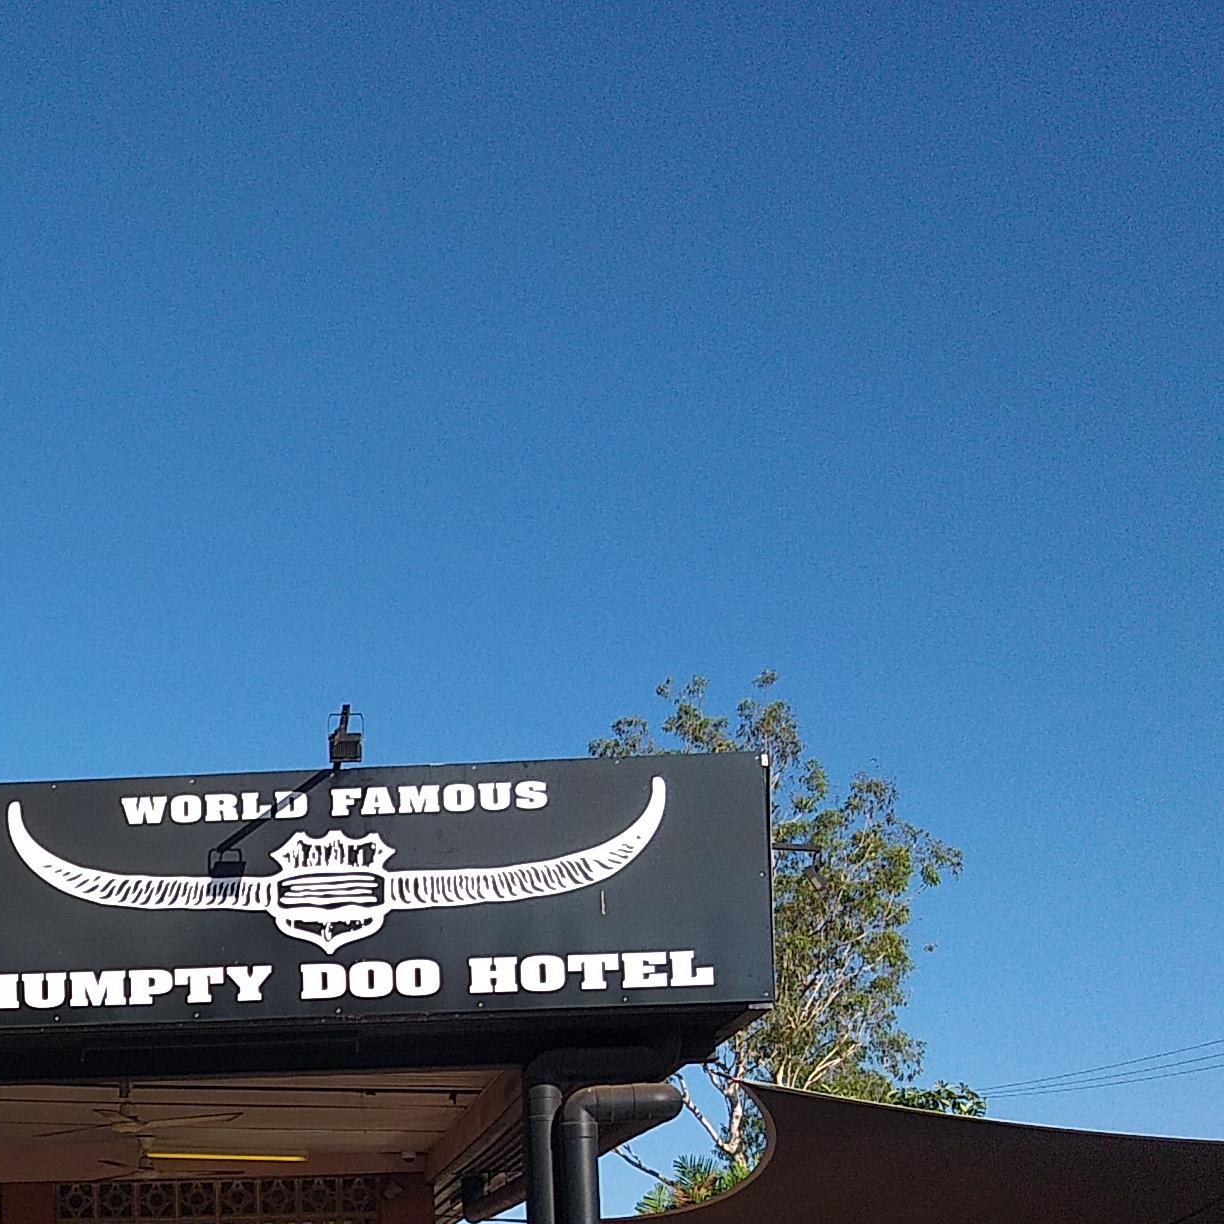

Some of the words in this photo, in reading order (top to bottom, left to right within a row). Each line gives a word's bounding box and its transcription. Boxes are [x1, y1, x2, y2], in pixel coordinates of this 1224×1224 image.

[121, 790, 308, 825] WORLD
[330, 780, 548, 817] FAMOUS
[301, 959, 440, 1000] DOO
[469, 950, 715, 995] HOTEL
